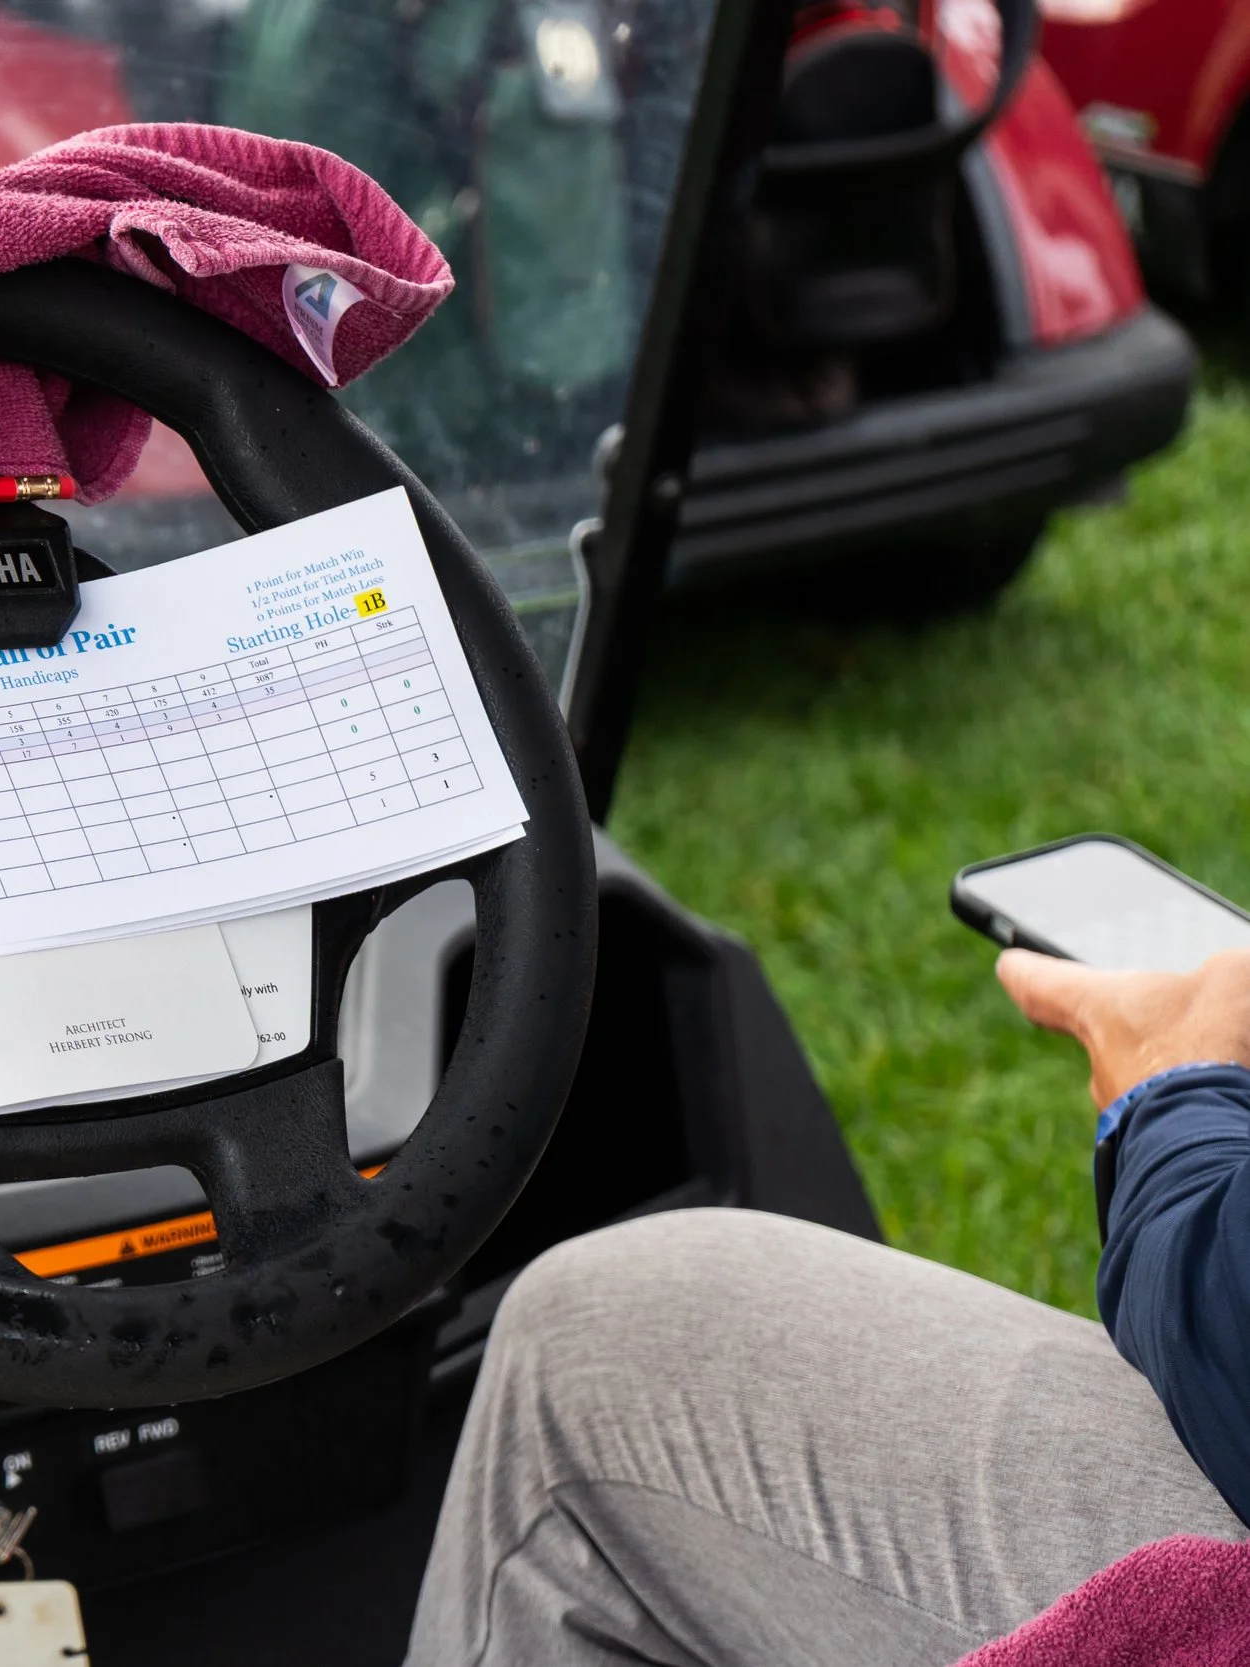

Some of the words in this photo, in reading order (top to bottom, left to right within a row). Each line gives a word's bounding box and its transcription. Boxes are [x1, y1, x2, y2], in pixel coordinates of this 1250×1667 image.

[251, 595, 270, 609] 1/2
[271, 586, 301, 601] Point
[303, 579, 319, 591] for
[320, 570, 347, 585] Tied
[347, 558, 384, 578] Match
[254, 577, 284, 592] Point
[285, 569, 302, 582] for
[303, 558, 339, 579] Match
[340, 549, 365, 564] Win
[266, 603, 301, 619] Points
[304, 595, 319, 608] for
[322, 582, 358, 601] Match
[358, 574, 385, 590] Loss
[69, 623, 137, 654] Pair
[200, 674, 206, 682] 9
[249, 657, 269, 669] Total
[315, 640, 328, 650] PH
[376, 620, 393, 630] Strk
[227, 622, 303, 653] Starting
[0, 667, 79, 690] Handicaps
[9, 725, 24, 733] 158
[57, 717, 72, 726] 355
[105, 709, 120, 717] 420
[153, 699, 168, 709] 175
[202, 688, 217, 697] 412
[255, 672, 274, 684] 3087
[341, 698, 348, 708] 0
[404, 679, 411, 689] 0
[19, 738, 25, 746] 3
[114, 722, 120, 730] 4
[265, 687, 275, 695] 35
[351, 724, 358, 734] 0
[414, 705, 421, 715] 0
[370, 771, 377, 781] 5
[432, 753, 439, 762] 3
[381, 798, 386, 807] 1
[444, 780, 449, 788] 1
[254, 982, 279, 994] with
[65, 1018, 126, 1035] ARCHITECT
[49, 1037, 101, 1054] HERBERT
[104, 1030, 153, 1046] STRONG
[93, 1428, 131, 1454] REV
[3, 1451, 33, 1473] ON
